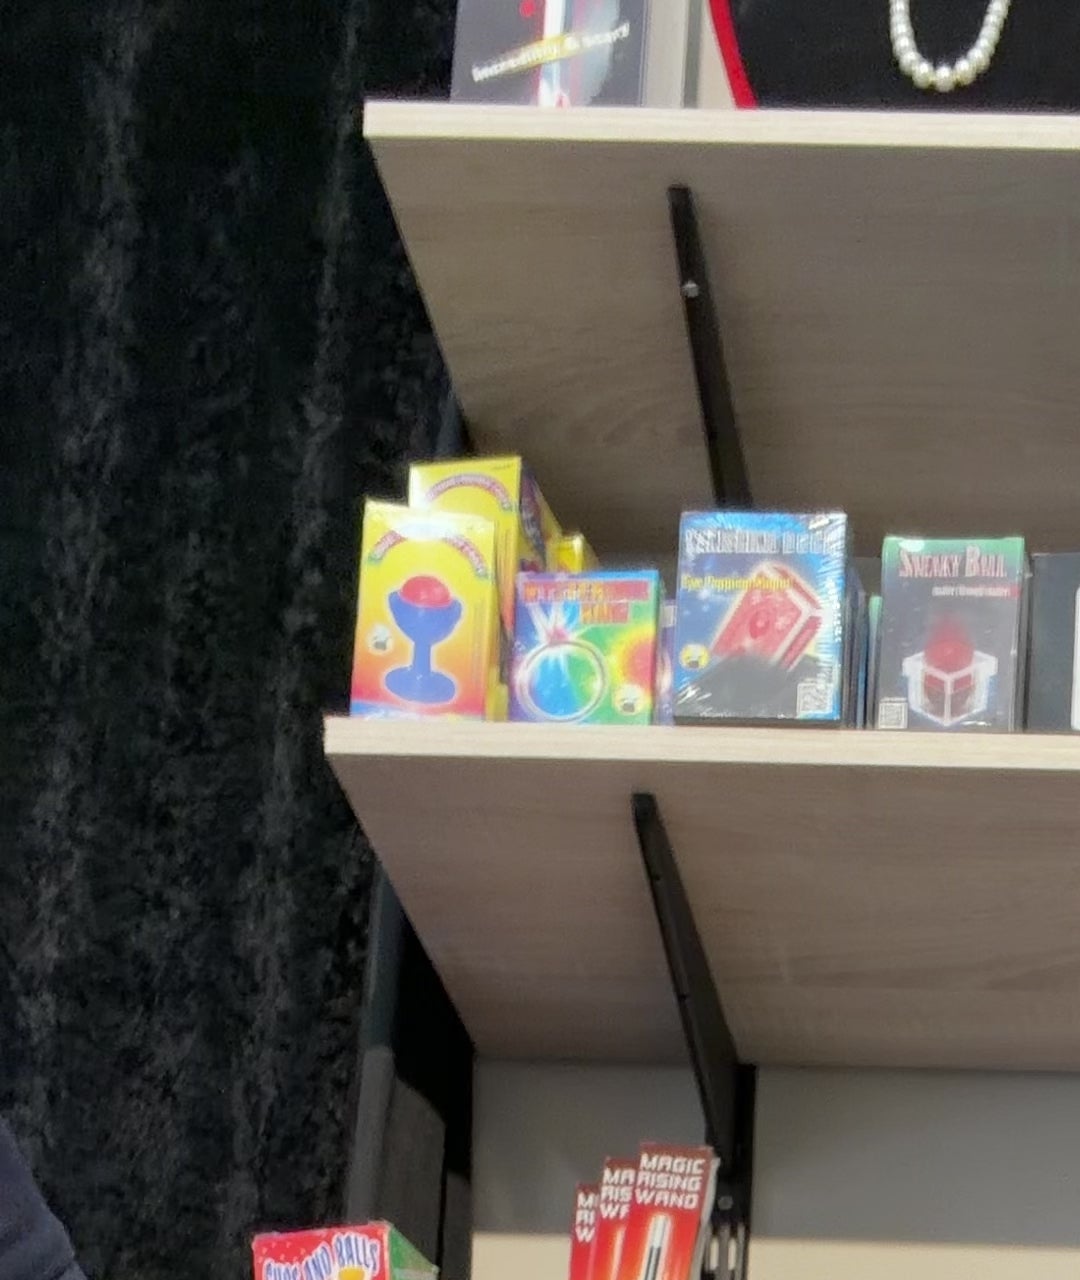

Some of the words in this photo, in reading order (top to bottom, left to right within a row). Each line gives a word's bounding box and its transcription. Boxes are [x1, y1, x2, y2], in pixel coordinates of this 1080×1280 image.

[640, 1153, 705, 1174] MAGIC
[637, 1171, 702, 1192] RISING
[635, 1188, 699, 1209] WAND
[334, 1233, 380, 1275] BALLS
